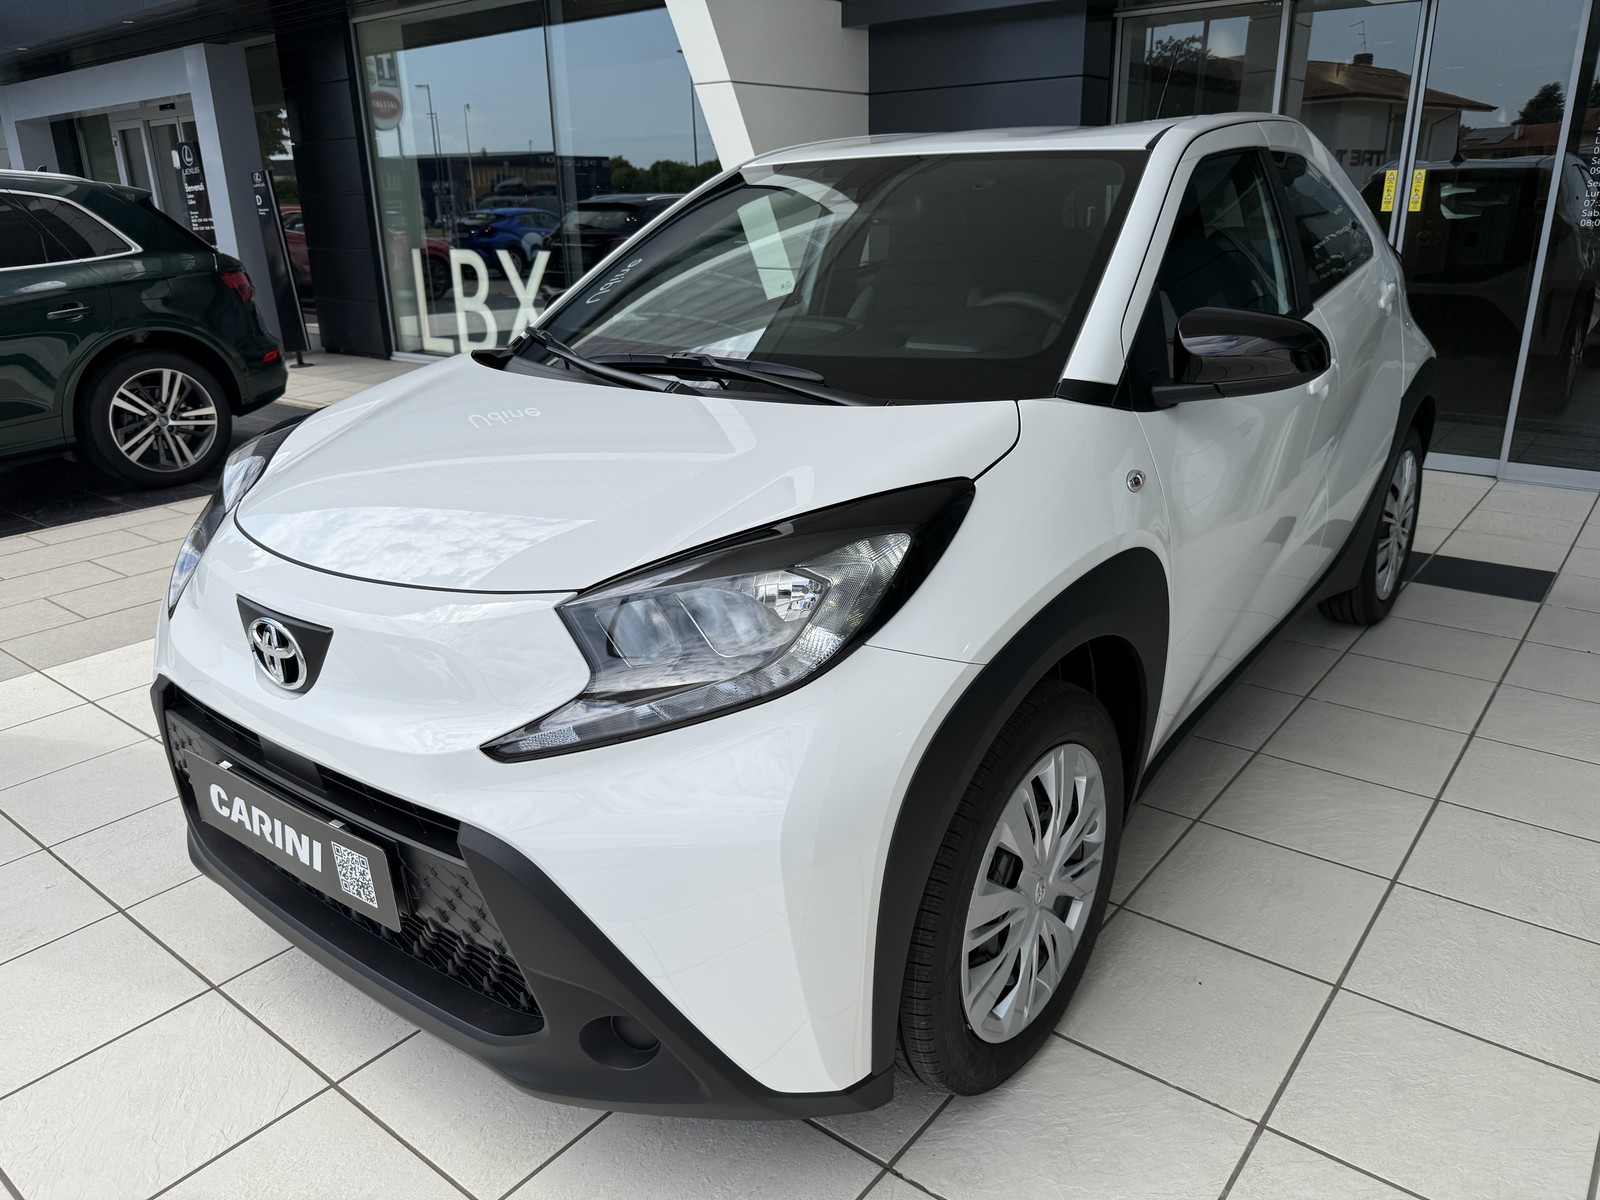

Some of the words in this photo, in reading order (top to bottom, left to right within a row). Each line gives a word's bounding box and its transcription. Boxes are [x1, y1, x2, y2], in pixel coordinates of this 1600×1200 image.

[182, 167, 200, 176] LEXUS
[411, 248, 551, 354] LBX
[209, 783, 322, 873] CARINI
